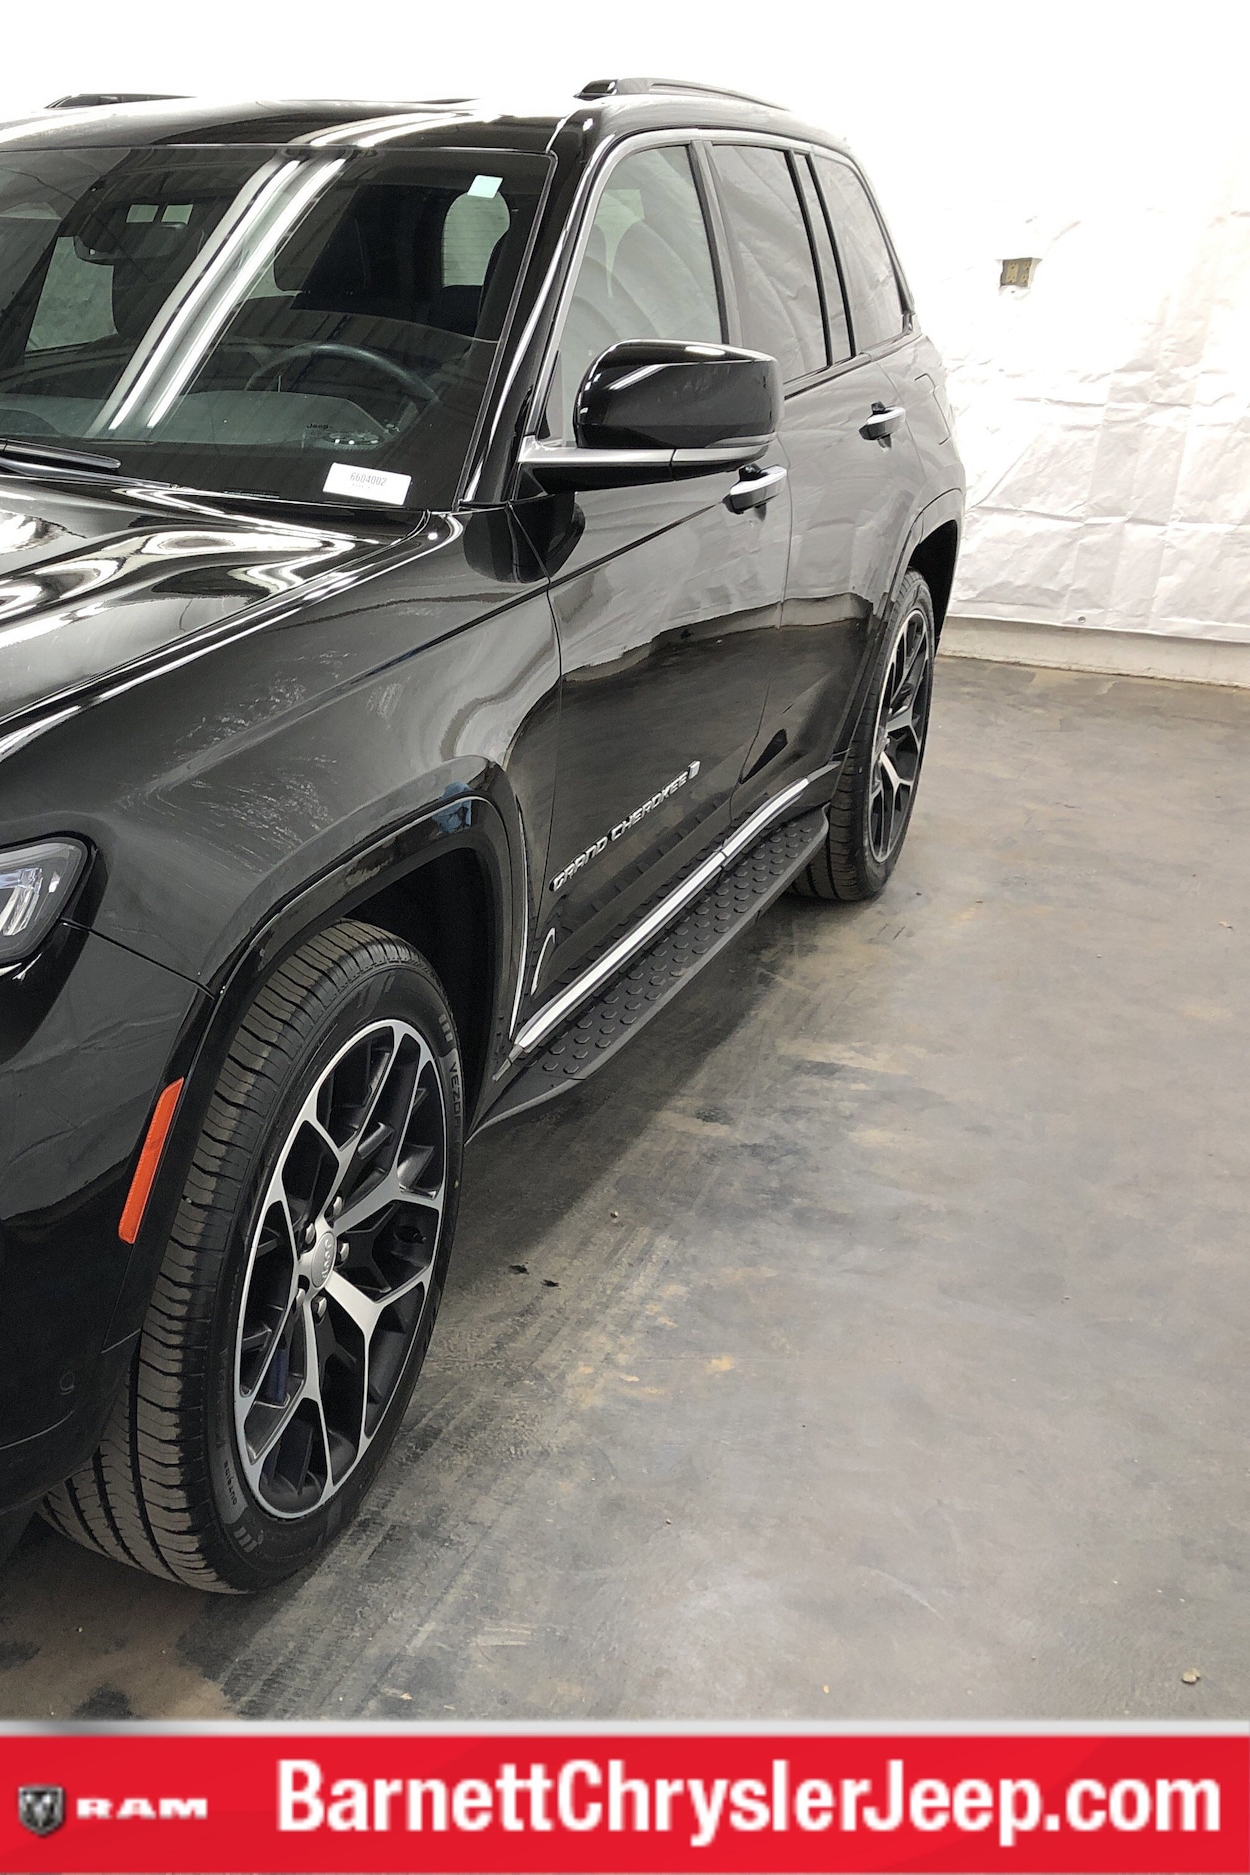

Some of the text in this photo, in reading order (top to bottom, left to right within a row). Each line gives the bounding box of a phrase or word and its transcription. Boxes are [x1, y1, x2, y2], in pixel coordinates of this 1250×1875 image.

[350, 472, 387, 487] 6604002
[552, 771, 689, 892] GRAND CHEROKEE
